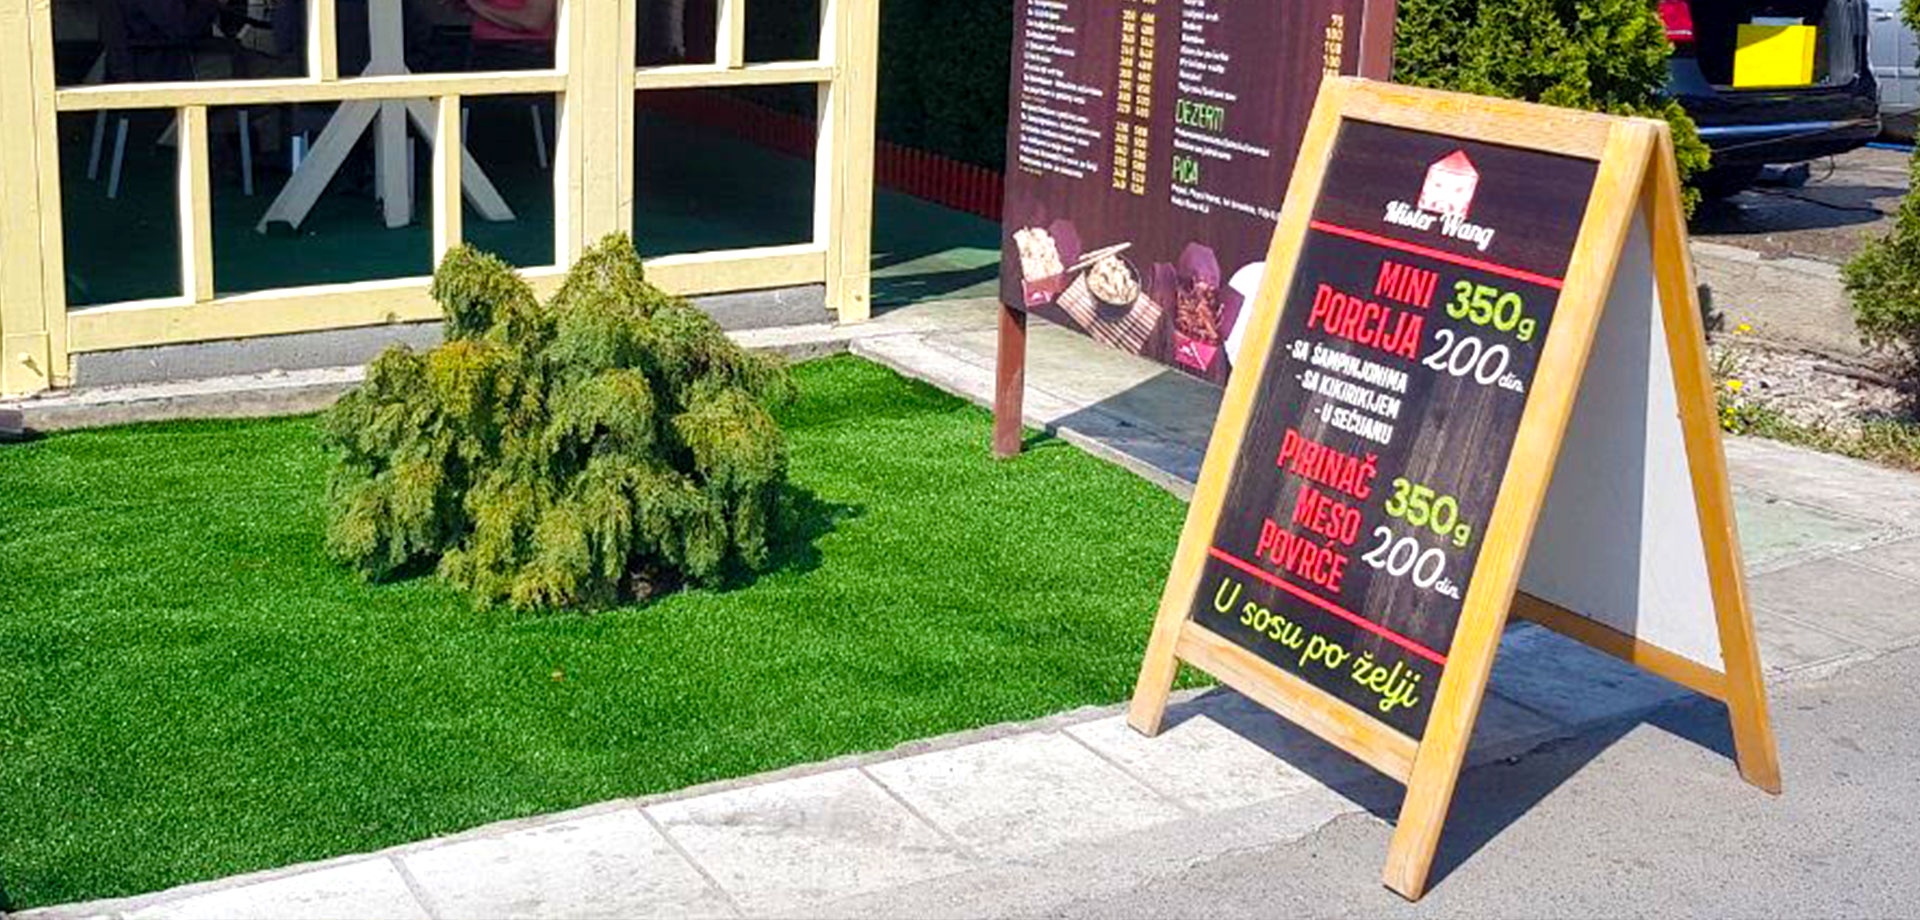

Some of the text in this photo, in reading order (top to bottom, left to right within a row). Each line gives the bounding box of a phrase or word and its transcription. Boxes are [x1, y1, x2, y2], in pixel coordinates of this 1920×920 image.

[1383, 200, 1495, 251] Mister Wang
[1375, 260, 1440, 309] MINI
[1307, 283, 1424, 361] PORCIJA
[1318, 374, 1401, 420] KIKIRIKIJEM
[1276, 428, 1379, 500] PIRINAČ
[1291, 482, 1363, 546] MESO
[1254, 517, 1349, 593] POVRĆE
[1213, 577, 1421, 712] U sosu po želji
